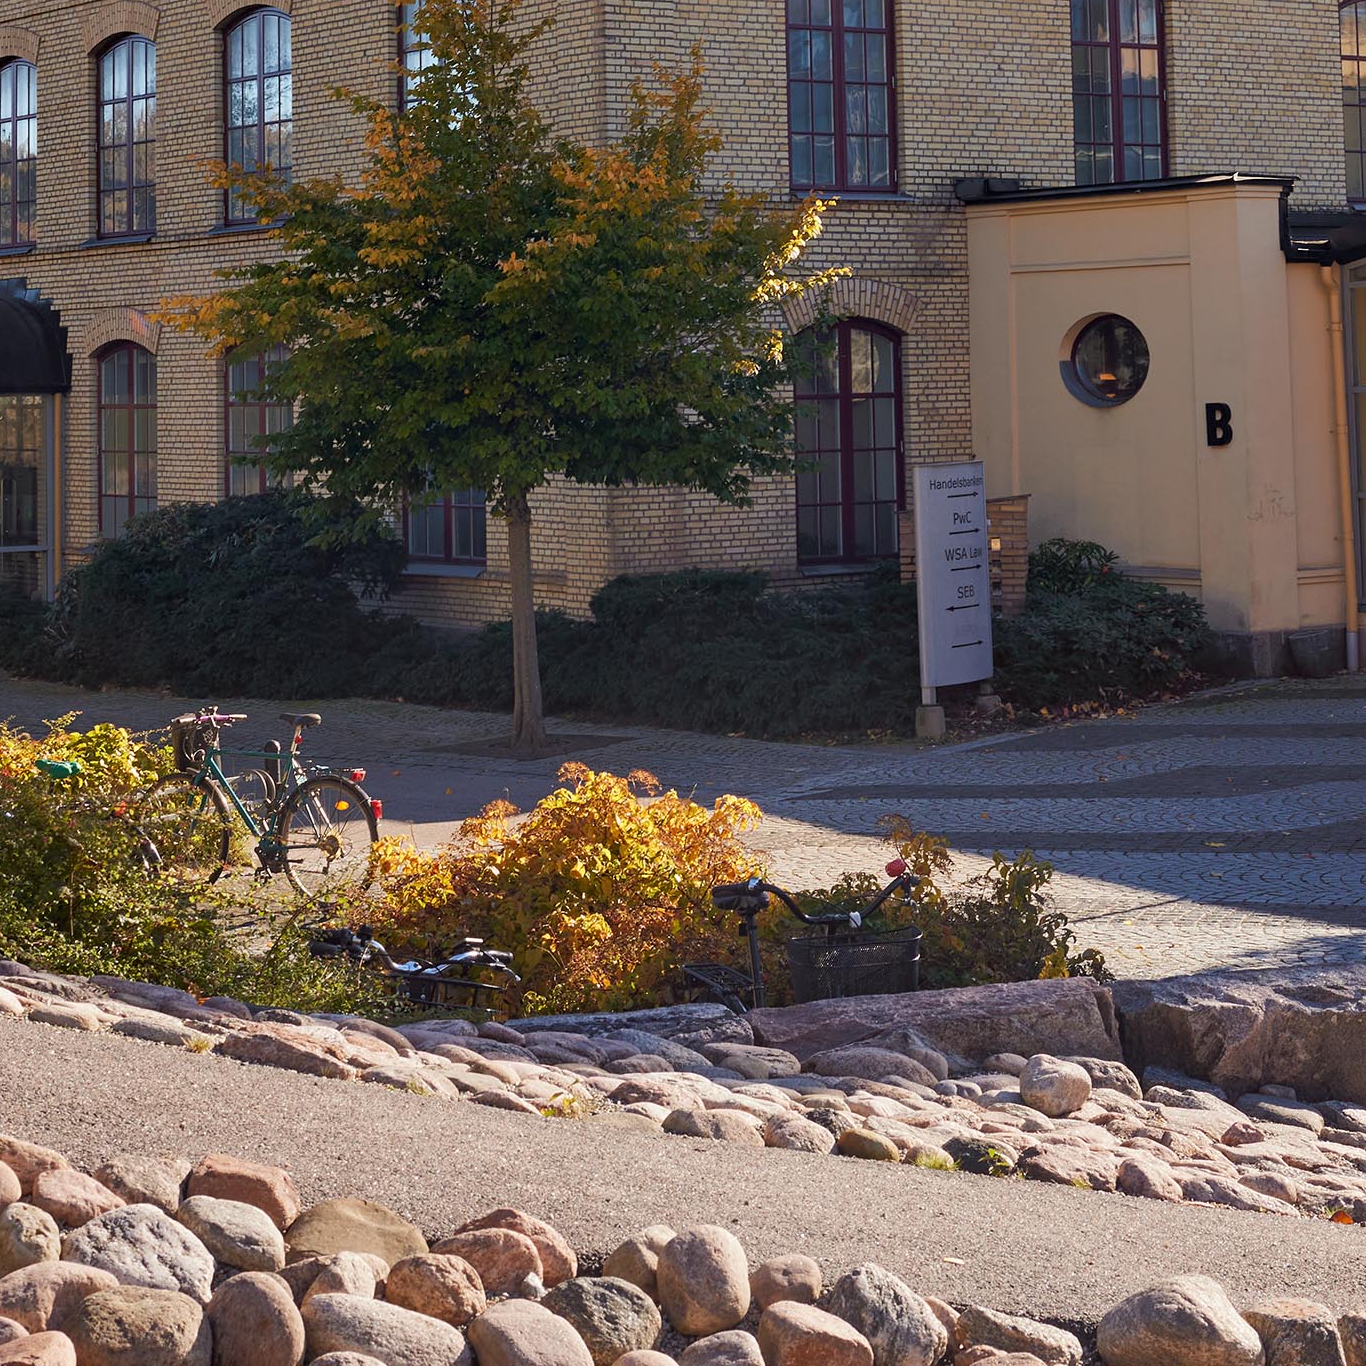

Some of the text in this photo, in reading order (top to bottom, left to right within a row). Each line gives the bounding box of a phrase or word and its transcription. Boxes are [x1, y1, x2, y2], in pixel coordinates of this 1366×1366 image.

[1205, 402, 1233, 447] B
[953, 511, 972, 525] PwC
[945, 546, 982, 562] WSA Law
[957, 585, 975, 599] SEB
